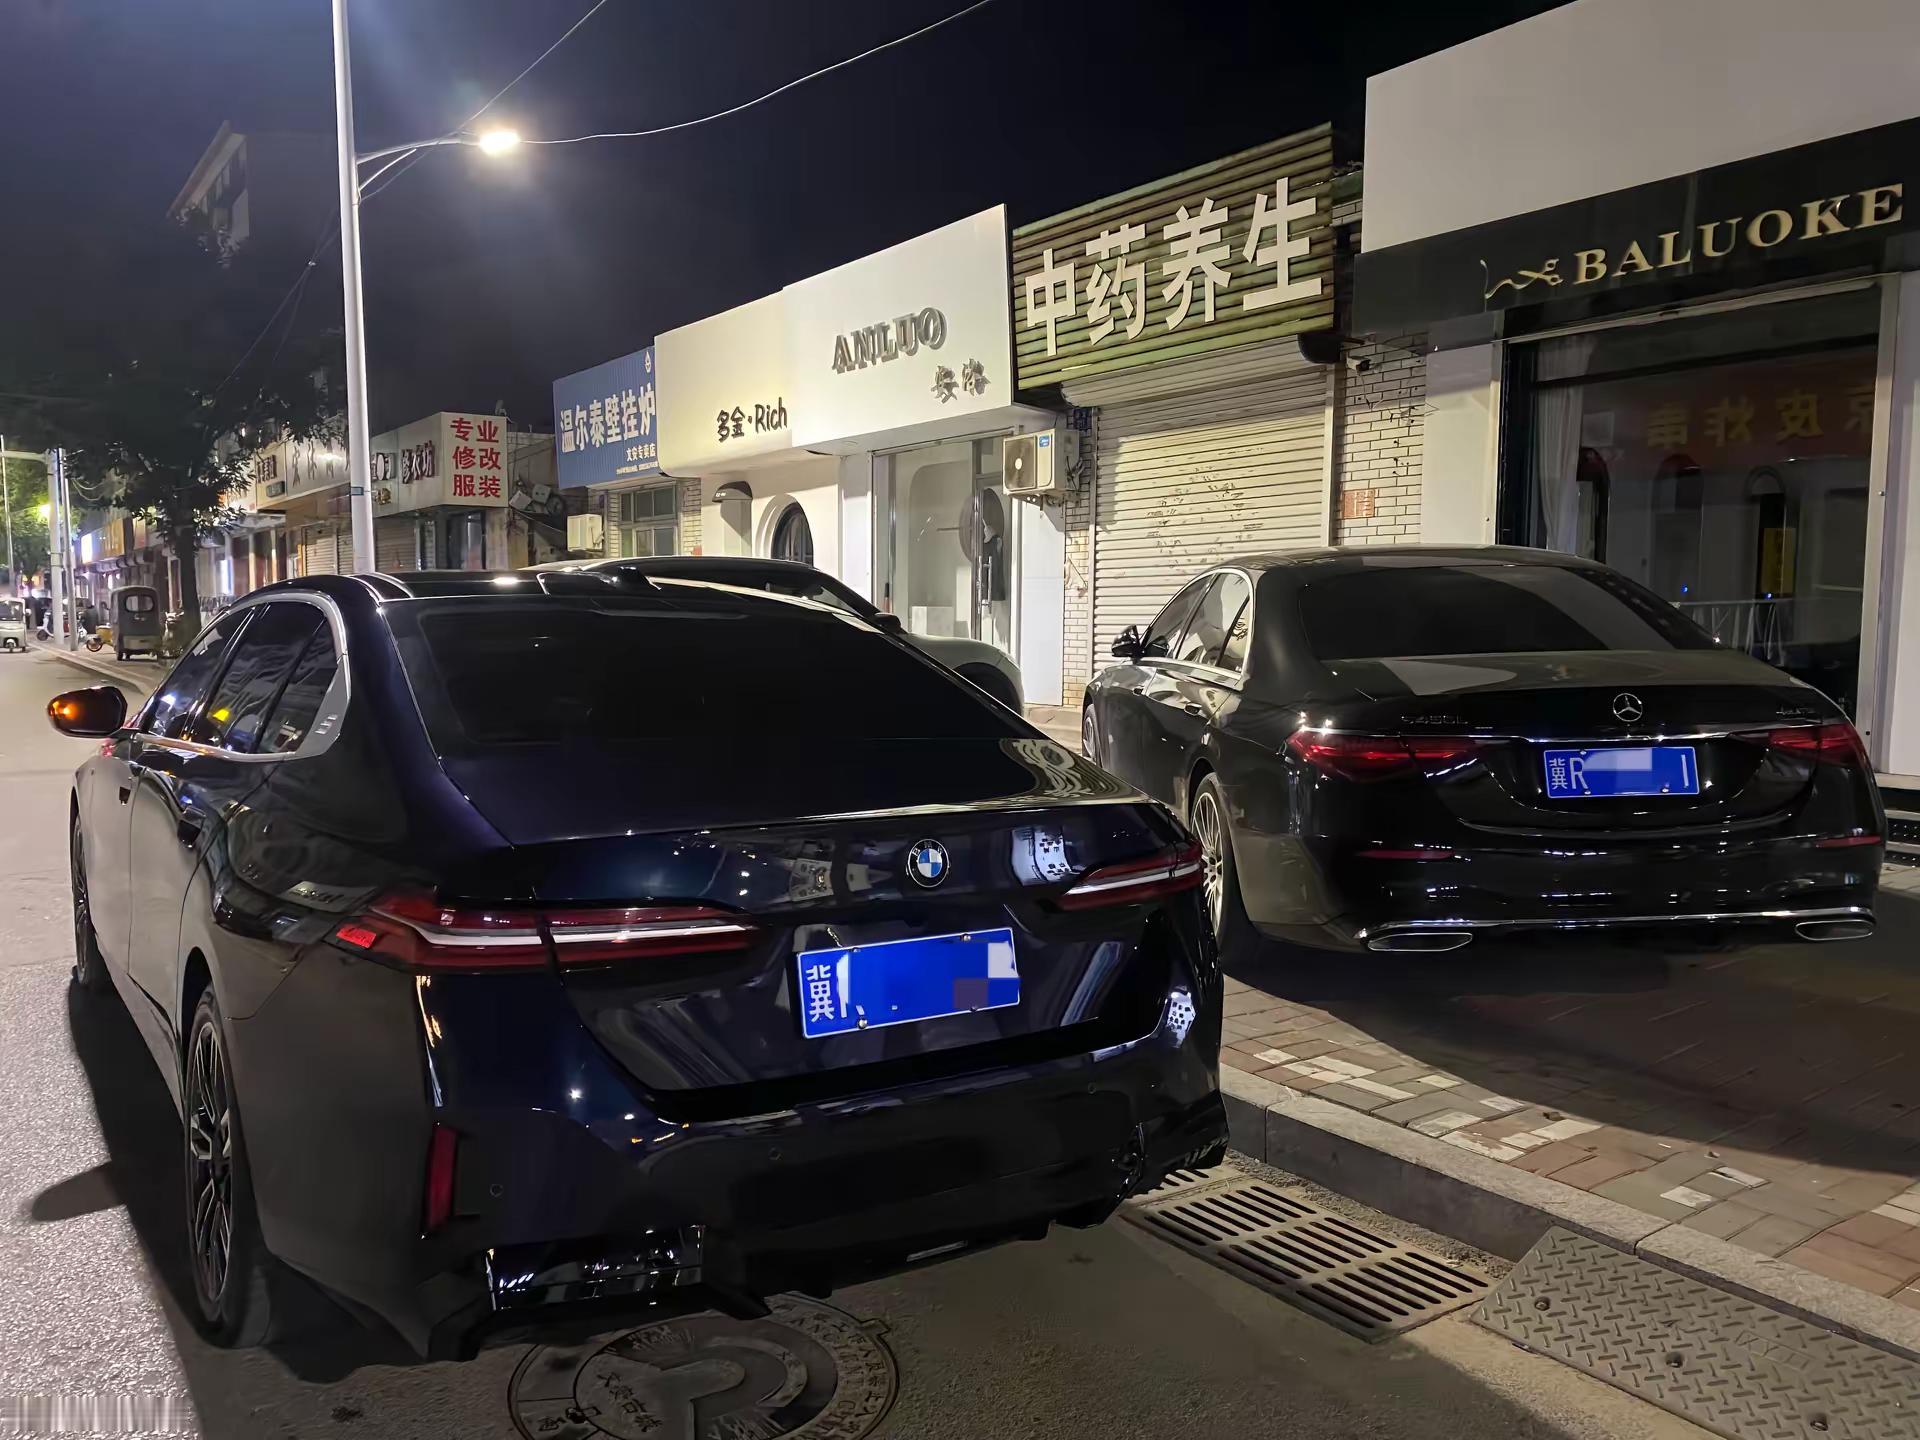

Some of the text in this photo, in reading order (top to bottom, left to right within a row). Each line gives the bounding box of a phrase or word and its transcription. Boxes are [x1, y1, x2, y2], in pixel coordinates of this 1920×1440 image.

[1573, 183, 1903, 285] BALUOKE
[1025, 177, 1322, 356] 中药养生
[831, 307, 947, 374] ANLUO
[450, 418, 499, 443] 专业
[560, 382, 656, 453] 温尔泰壁挂炉
[452, 446, 501, 470] 修改
[626, 442, 656, 462] 文安专卖店
[452, 474, 501, 498] 服装
